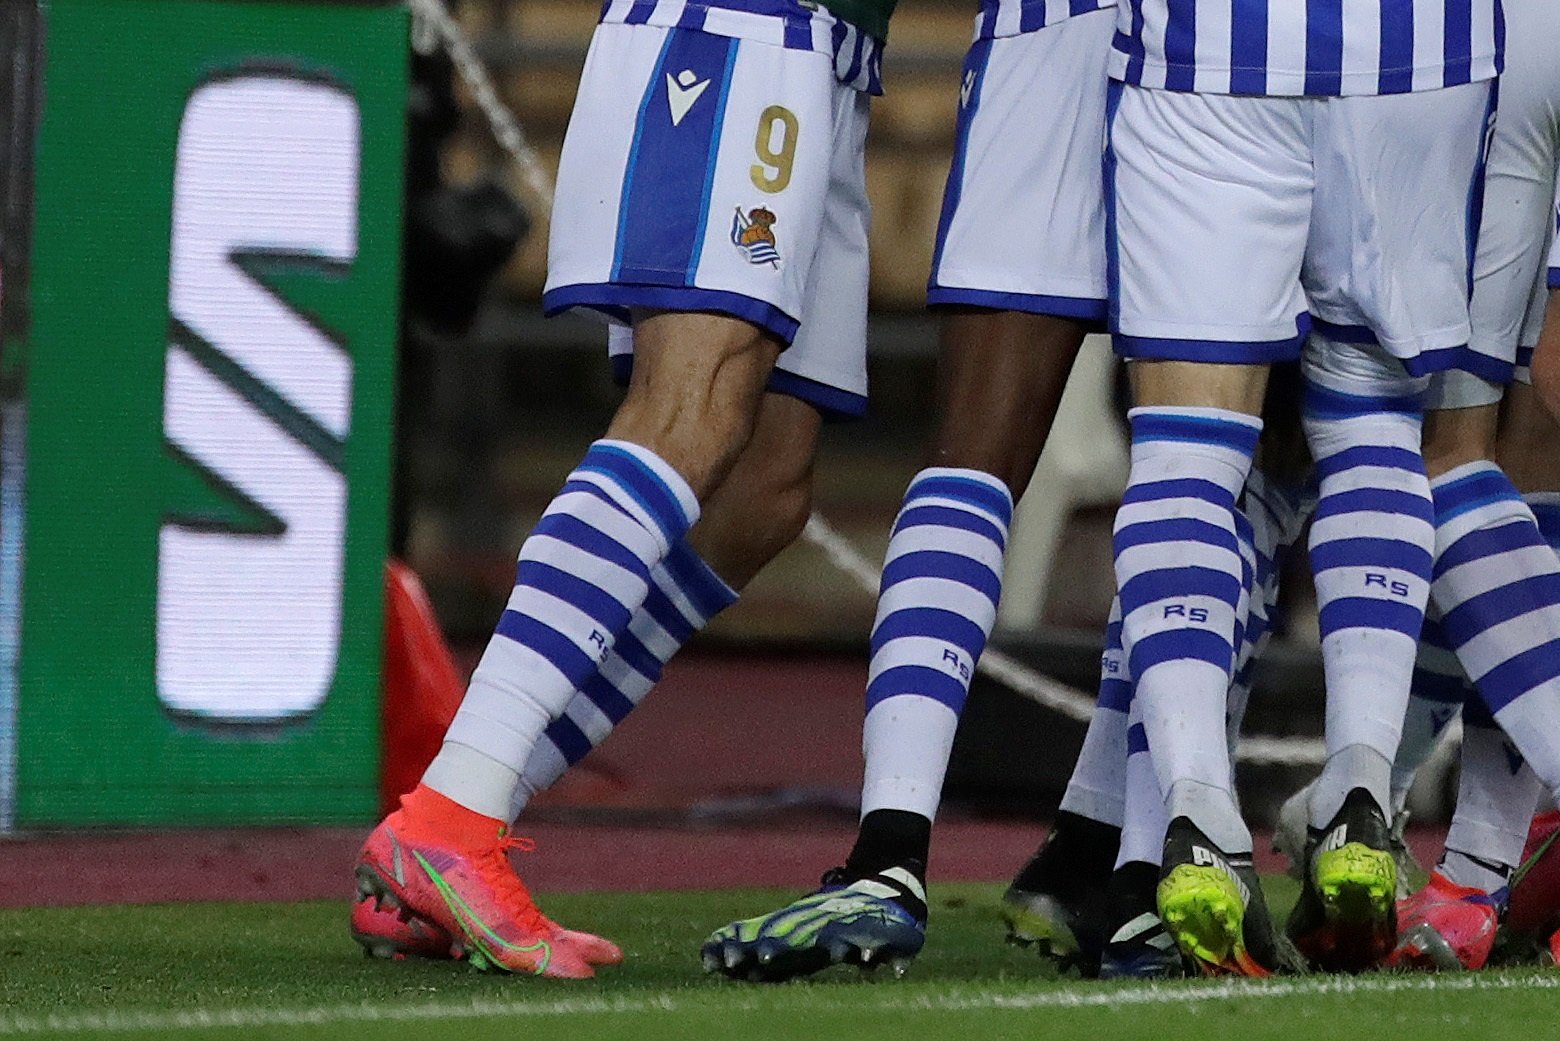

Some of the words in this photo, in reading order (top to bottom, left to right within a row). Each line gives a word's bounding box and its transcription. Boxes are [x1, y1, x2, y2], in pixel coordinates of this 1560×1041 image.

[749, 105, 798, 194] 9
[1364, 572, 1409, 597] RS
[1164, 604, 1209, 623] RS
[588, 629, 610, 663] RS
[942, 648, 970, 680] RS
